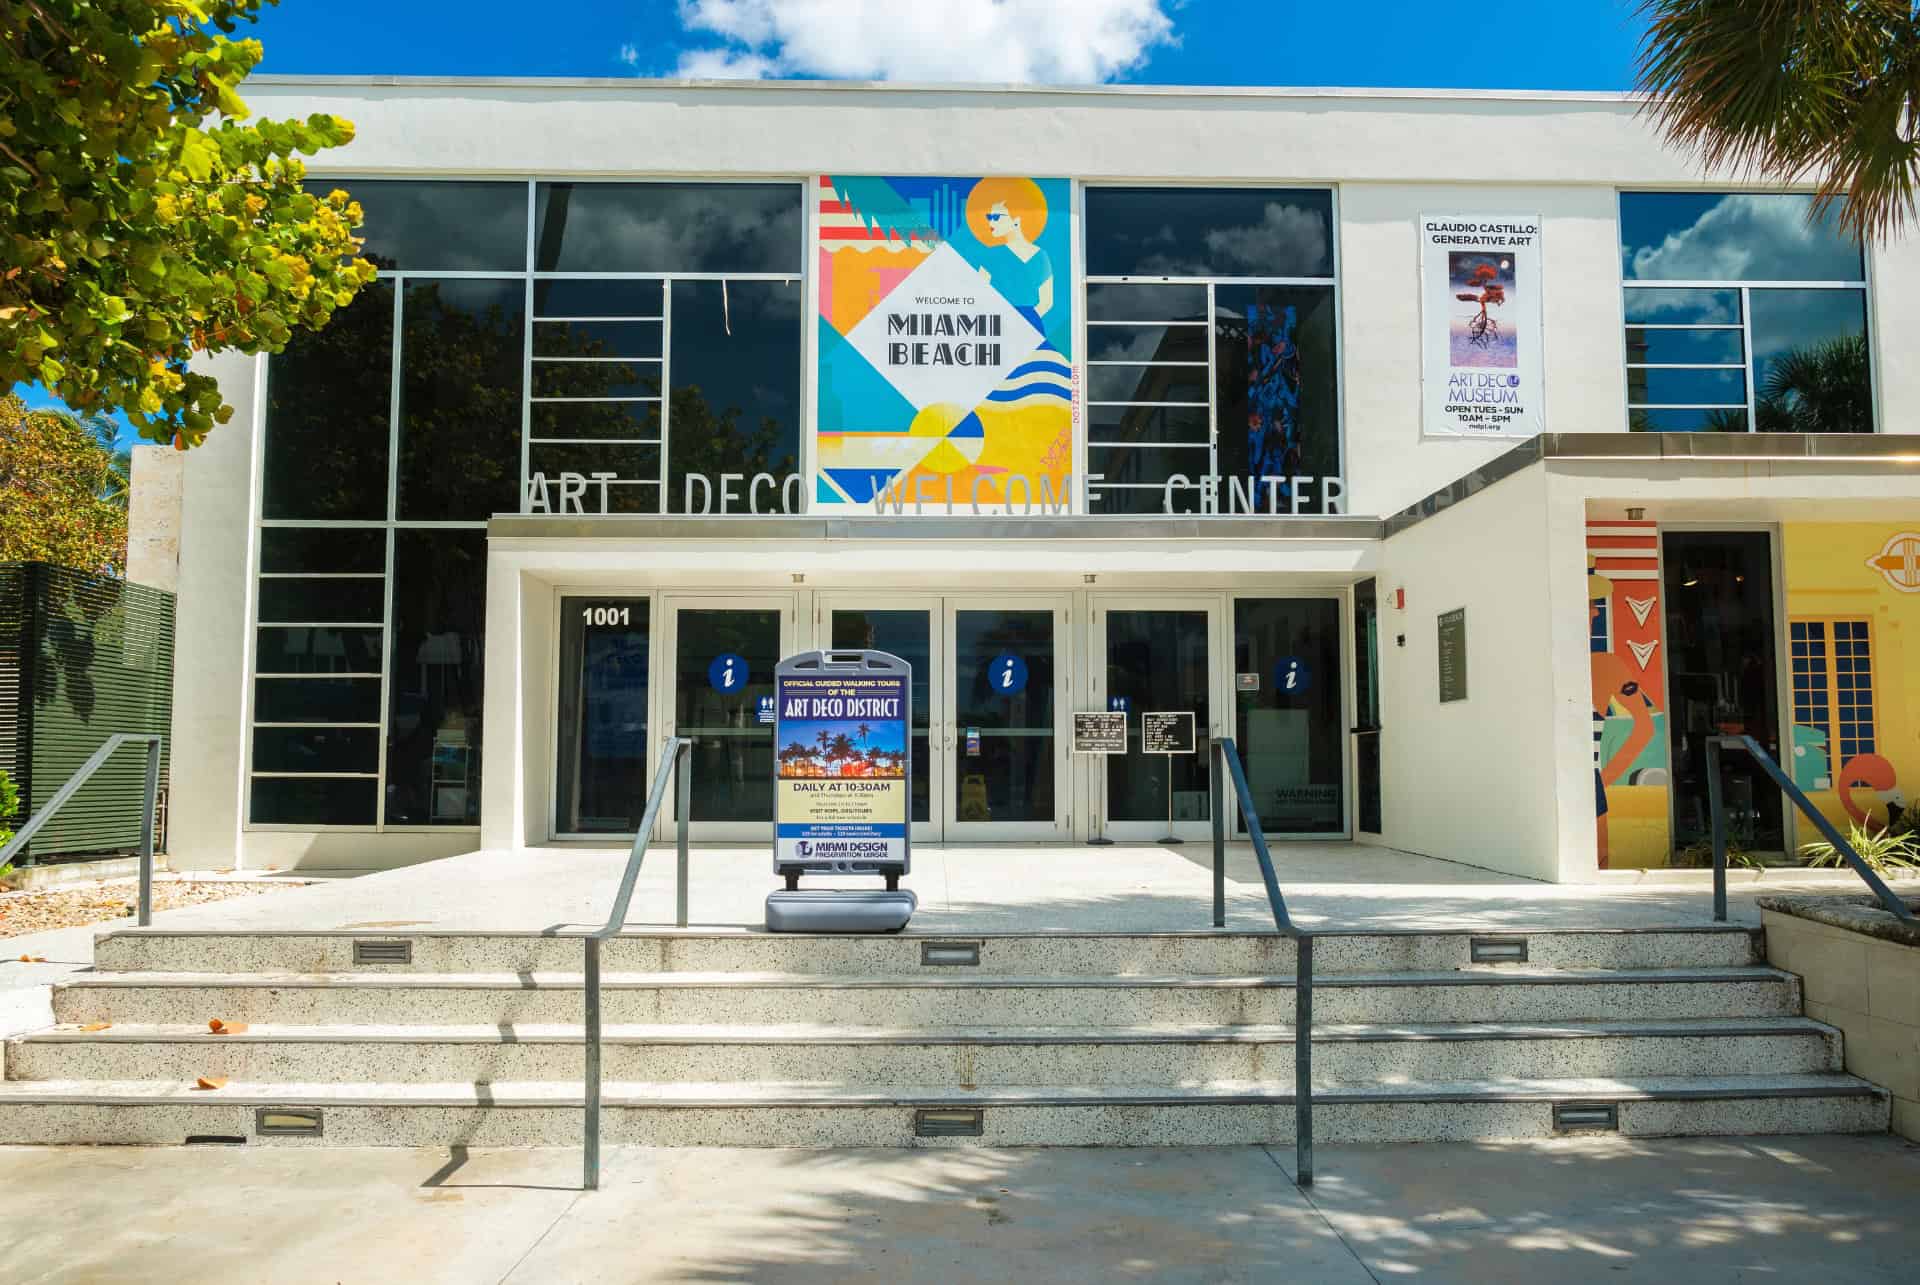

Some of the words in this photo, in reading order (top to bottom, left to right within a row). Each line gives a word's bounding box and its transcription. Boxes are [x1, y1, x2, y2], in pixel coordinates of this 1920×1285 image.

[1425, 222, 1478, 233] CLAUDIO
[1479, 223, 1538, 235] CASTILLO:
[1431, 234, 1506, 246] GENERATIVE
[1508, 236, 1532, 246] ART
[914, 296, 961, 305] WELCOME
[963, 297, 975, 305] TO
[887, 313, 1001, 337] MIAMI
[888, 342, 1001, 367] BEACH
[1448, 373, 1473, 388] ART
[1448, 387, 1519, 404] MUSEUM
[1444, 405, 1471, 414] OPEN
[1472, 406, 1497, 414] TUES
[1504, 406, 1524, 415] SUN
[1458, 414, 1483, 423] 10AM
[1491, 415, 1511, 423] 5PM
[525, 472, 618, 515] ART
[685, 473, 809, 515] DECO
[1162, 473, 1347, 515] CENTER
[582, 606, 631, 626] 1001
[827, 688, 838, 696] OF
[839, 688, 857, 696] THE
[784, 698, 809, 718] ART
[812, 698, 843, 718] DECO
[846, 698, 900, 718] DISTRICT
[793, 783, 825, 792] DAILY
[828, 783, 842, 792] AT
[845, 783, 891, 792] 10:30AM
[815, 842, 848, 852] MIAMI
[849, 842, 888, 852] DESIGN
